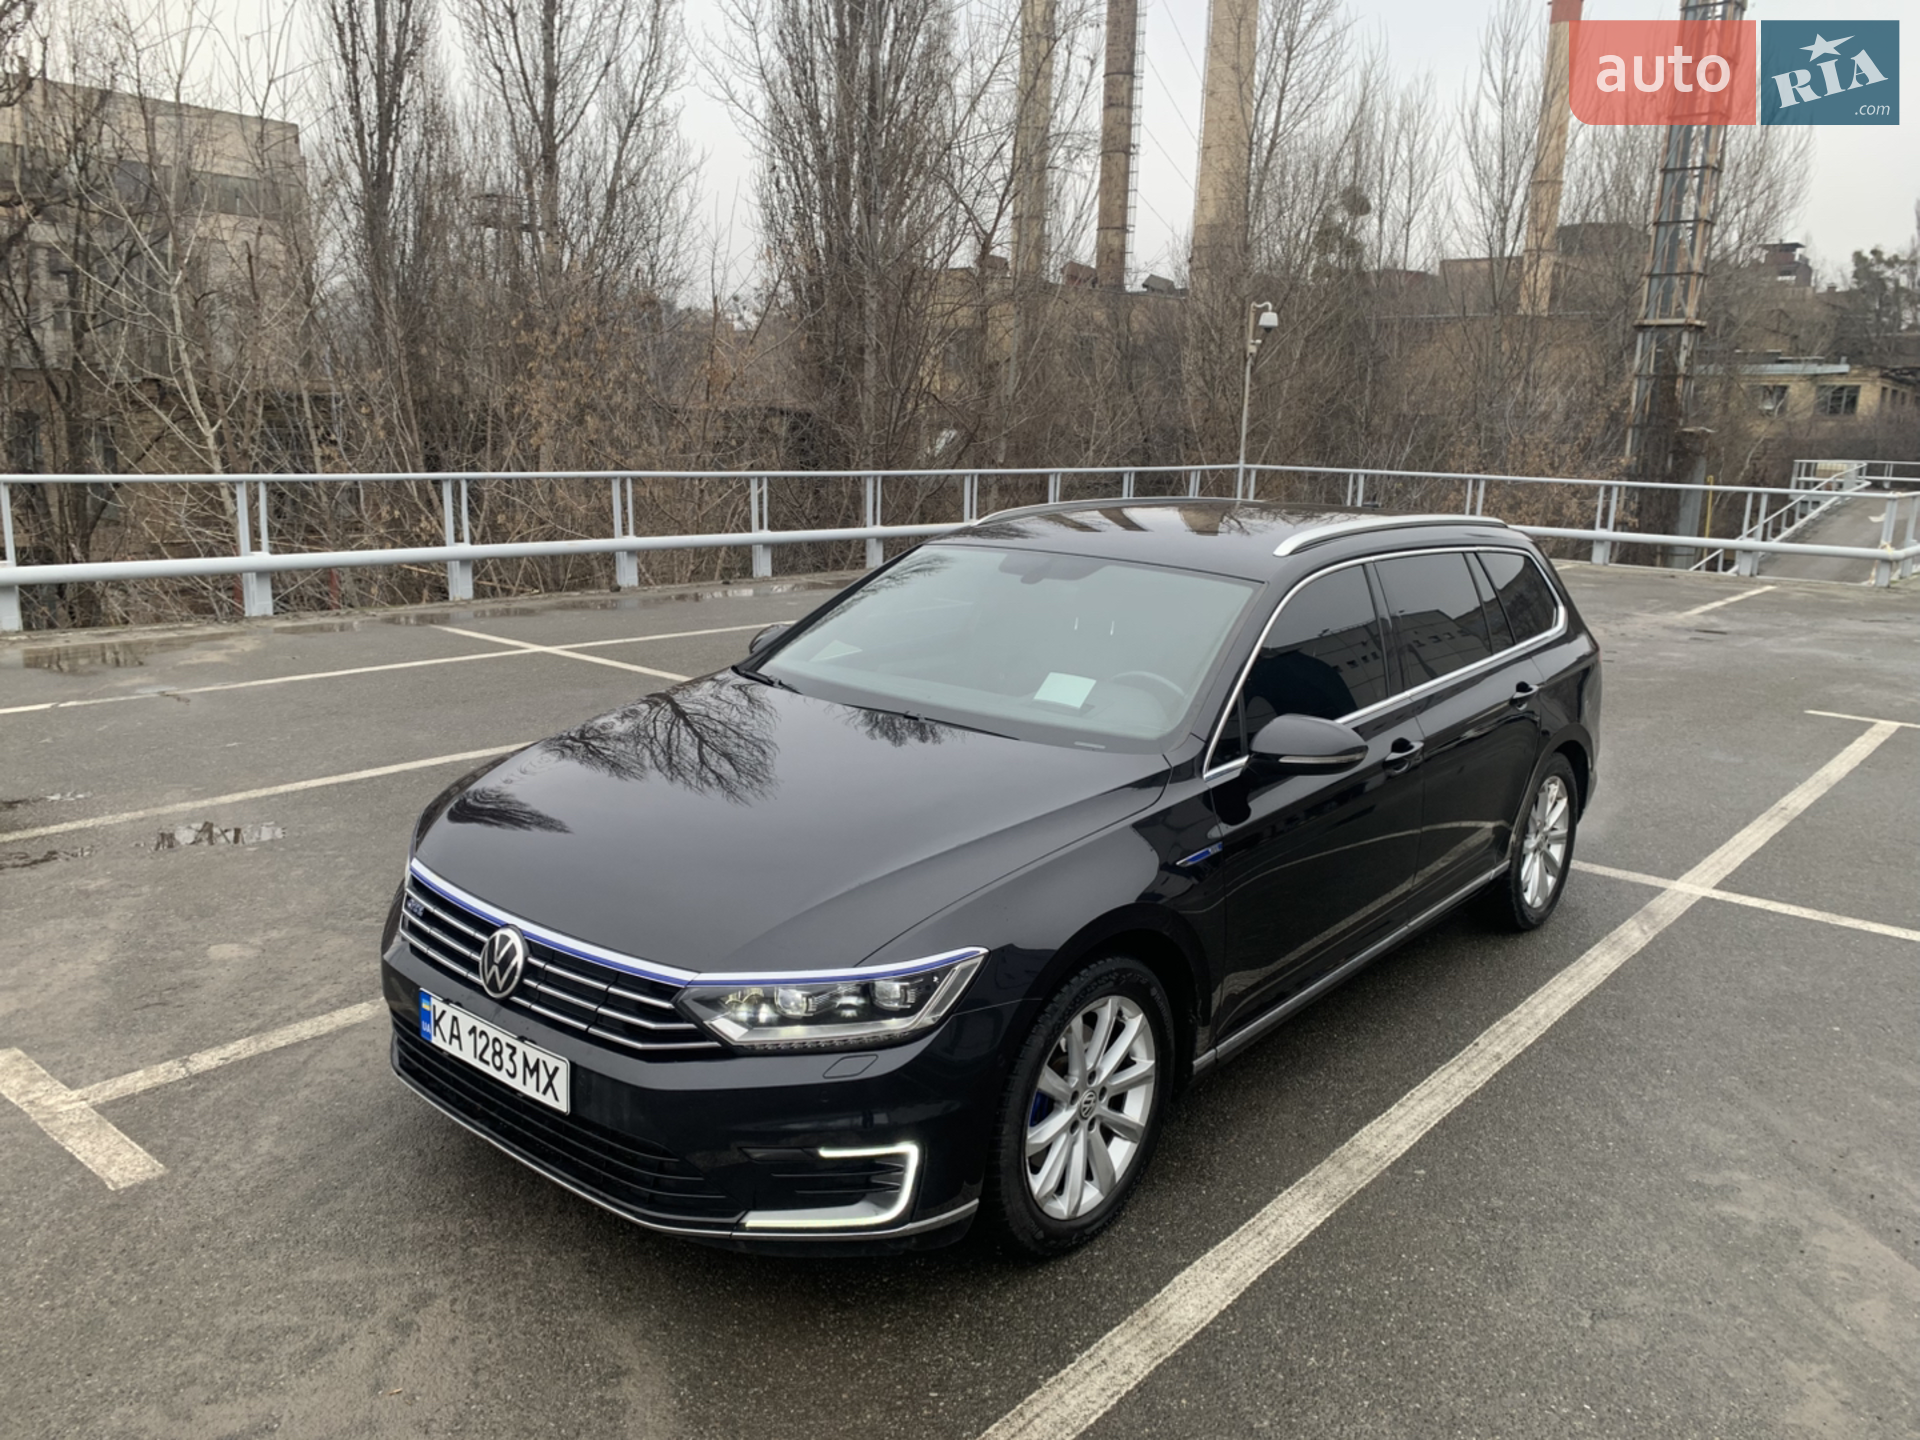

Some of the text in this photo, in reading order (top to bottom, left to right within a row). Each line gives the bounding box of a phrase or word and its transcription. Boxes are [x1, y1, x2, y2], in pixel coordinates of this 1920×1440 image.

[421, 1021, 431, 1033] UA
[432, 1004, 560, 1102] KA 1283 MX
